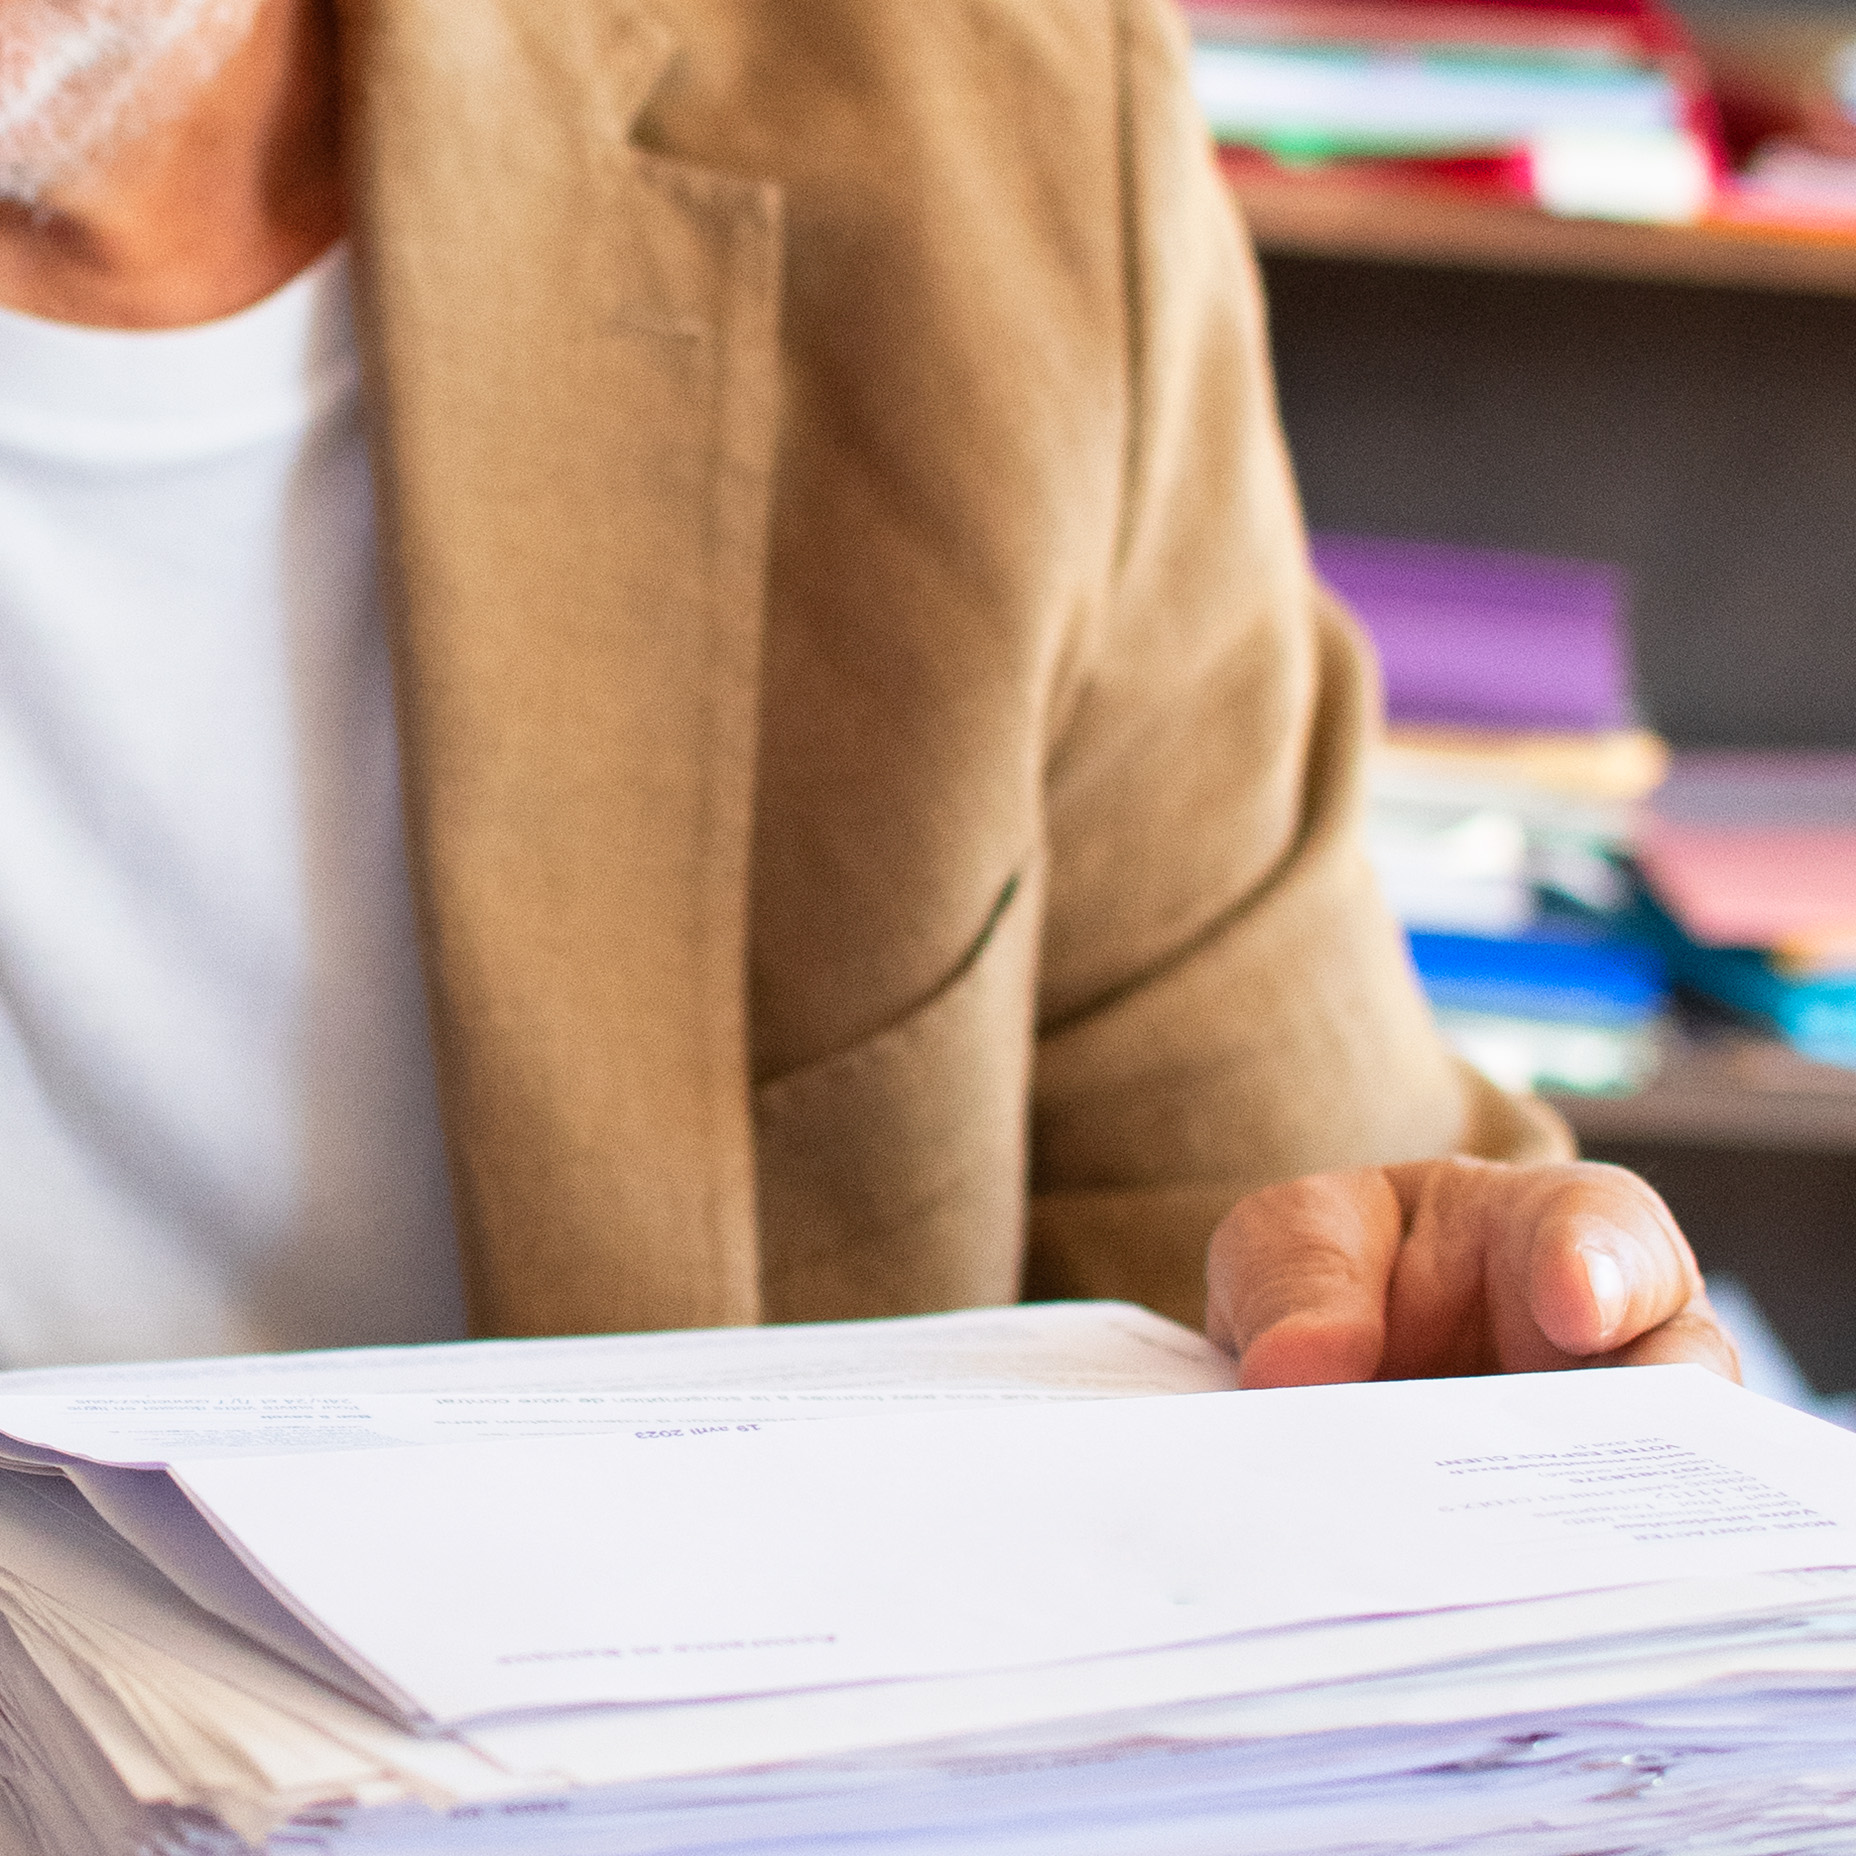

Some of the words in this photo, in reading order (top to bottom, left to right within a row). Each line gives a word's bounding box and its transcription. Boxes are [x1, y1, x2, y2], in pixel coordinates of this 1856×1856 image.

[612, 1394, 742, 1404] souscription
[688, 1425, 730, 1436] avril
[735, 1423, 761, 1433] 19
[633, 1429, 685, 1440] 2023
[1515, 1450, 1603, 1461] ESPACE
[1605, 1444, 1681, 1456] VOTRE
[1433, 1455, 1510, 1467] CLIENT
[1757, 1508, 1819, 1518] Votre
